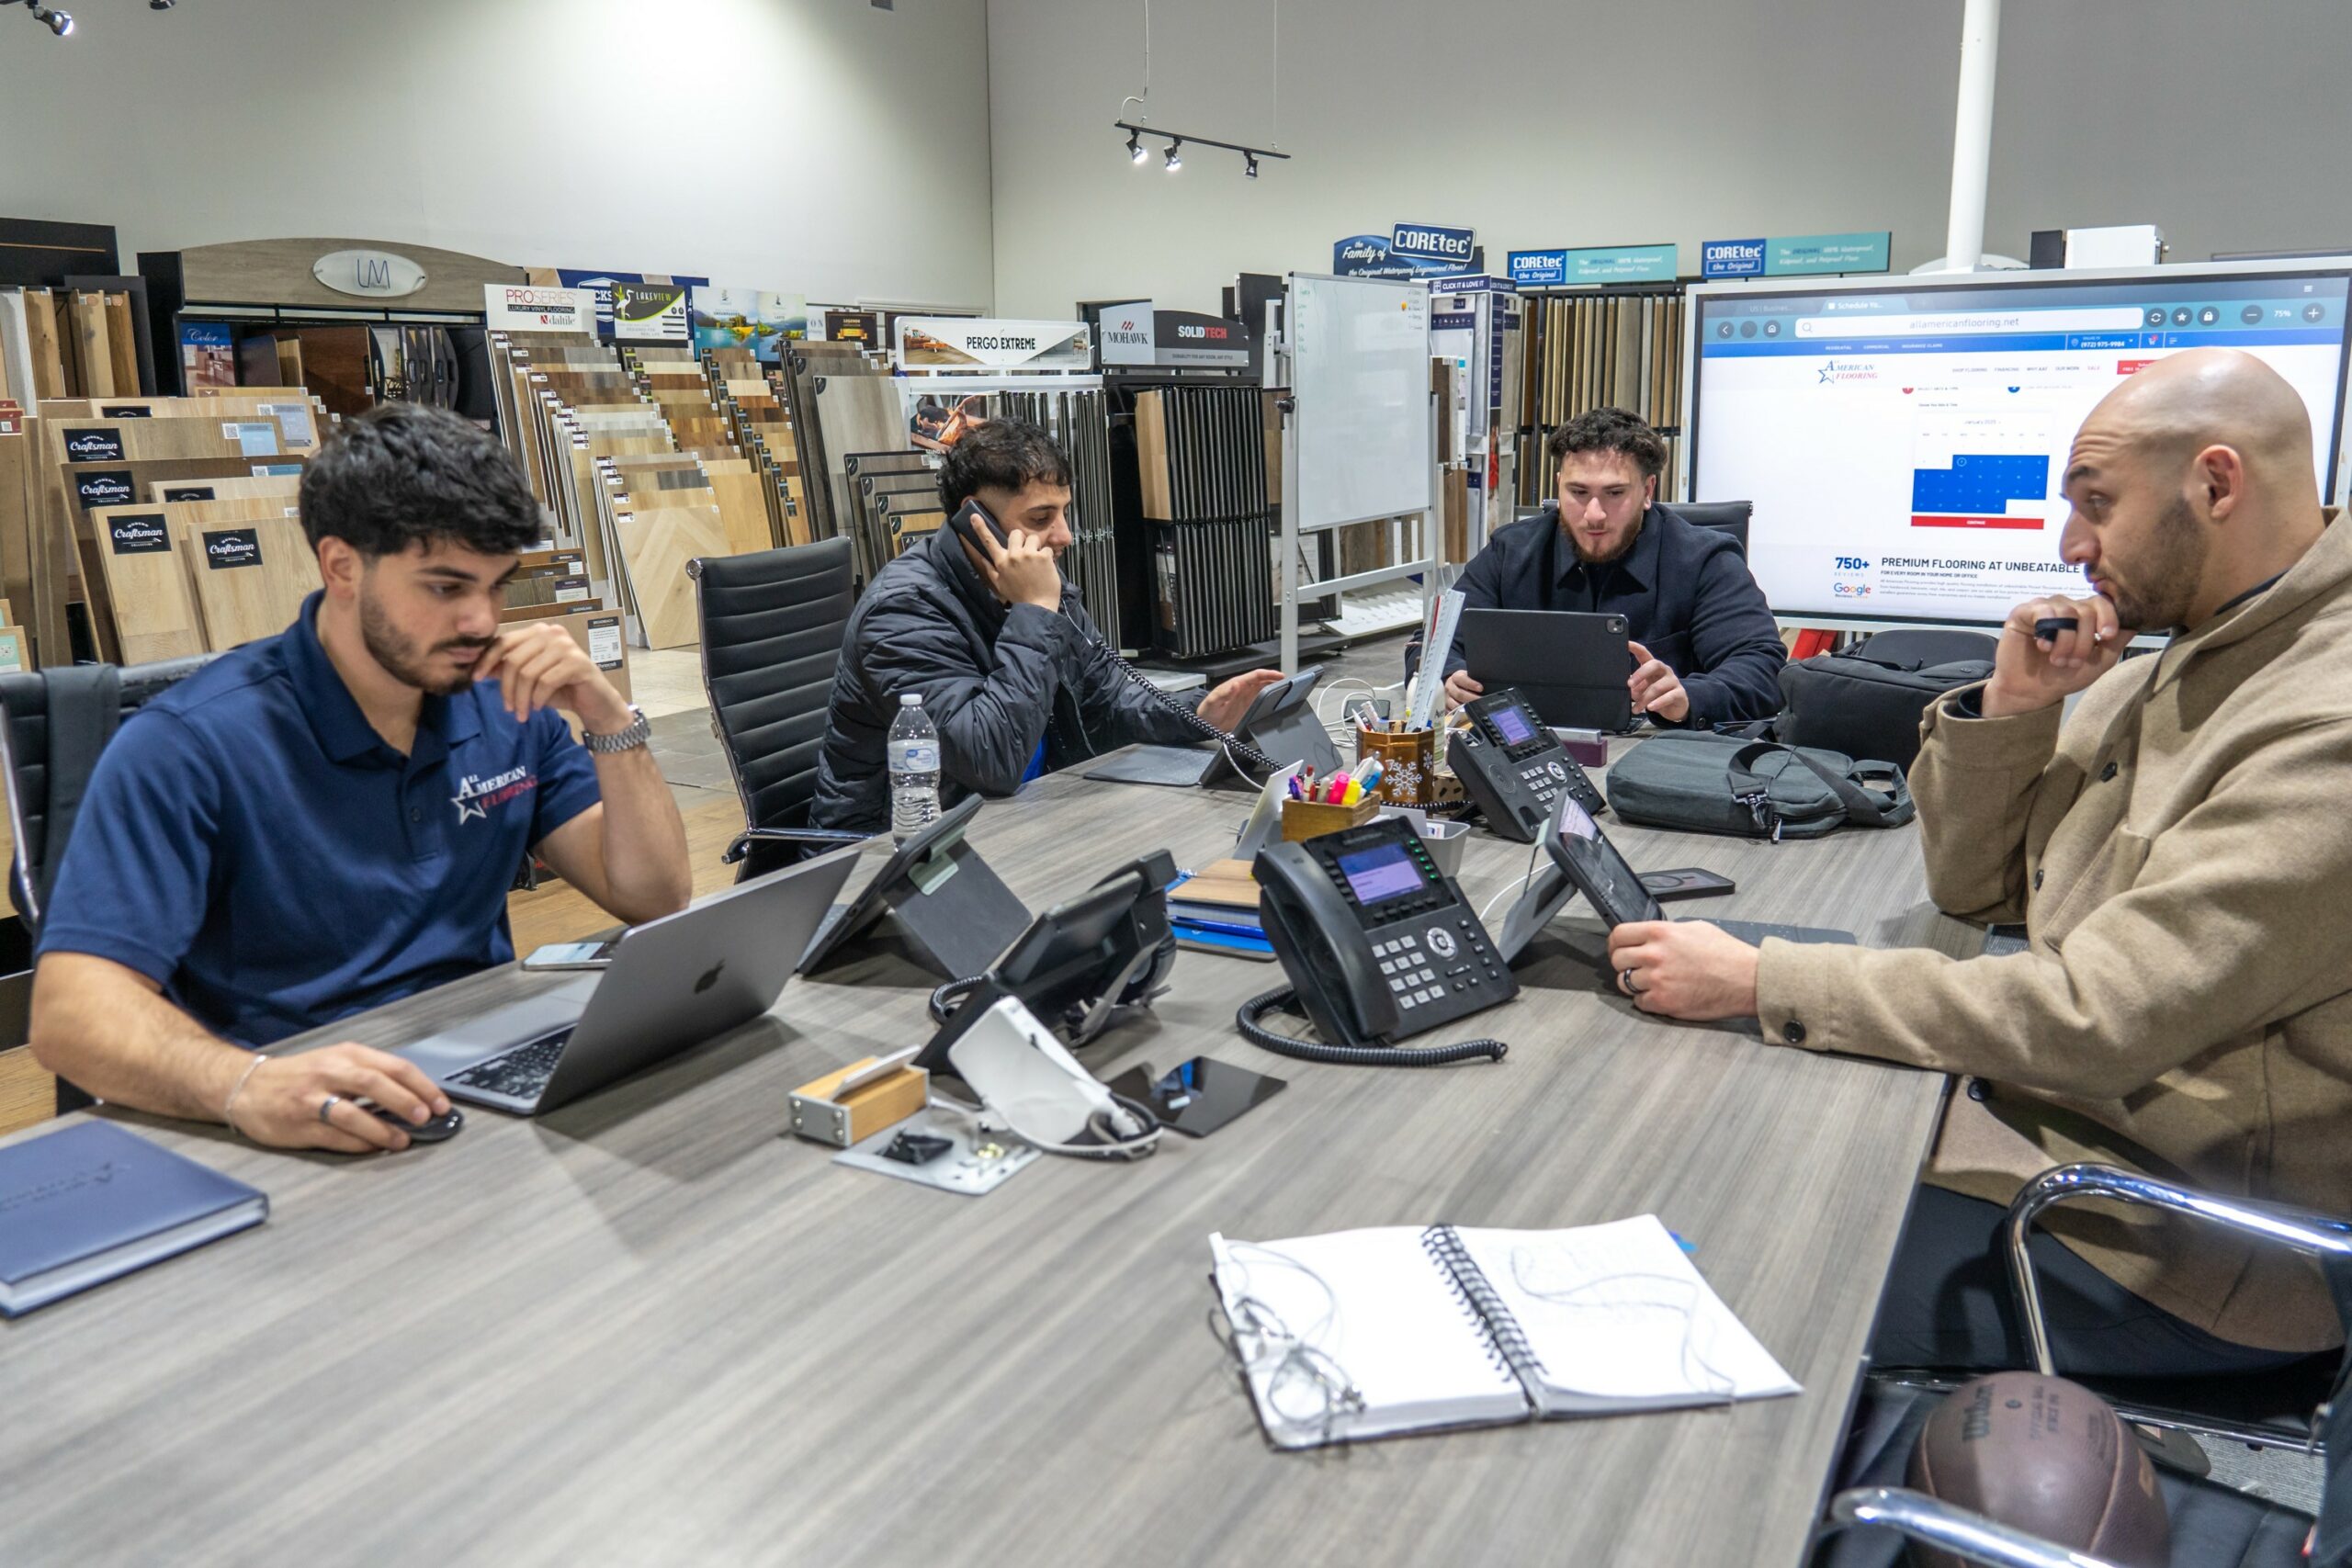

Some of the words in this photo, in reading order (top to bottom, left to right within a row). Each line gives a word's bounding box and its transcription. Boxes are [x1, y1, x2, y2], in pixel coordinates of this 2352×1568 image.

[1395, 230, 1468, 254] COREtec
[1342, 245, 1375, 264] Family
[1377, 247, 1385, 261] of
[1707, 244, 1761, 260] COREtec
[1513, 256, 1562, 269] COREtec
[1713, 263, 1725, 271] the
[1727, 262, 1755, 273] Original
[1532, 271, 1556, 281] Original
[506, 289, 574, 305] PROSERIES
[636, 290, 672, 302] LAKEVIEW
[549, 315, 575, 325] daltile
[2274, 310, 2291, 318] 75%
[1909, 317, 2019, 330] allamericanflooring.net
[1107, 332, 1148, 344] MOHAWK
[1178, 325, 1227, 339] SOLIDTECH
[967, 336, 999, 350] PERGO
[1001, 337, 1035, 350] EXTREME
[70, 441, 119, 453] Craftsman
[81, 484, 130, 496] Craftsman
[114, 526, 164, 539] Craftsman
[209, 542, 255, 555] Craftsman
[1835, 557, 1870, 570] 750+
[1882, 557, 1929, 568] PREMIUM
[1932, 558, 1985, 570] FLOORING
[1988, 561, 2003, 570] AT
[2006, 562, 2080, 573] UNBEATABLE
[1834, 582, 1871, 596] Google
